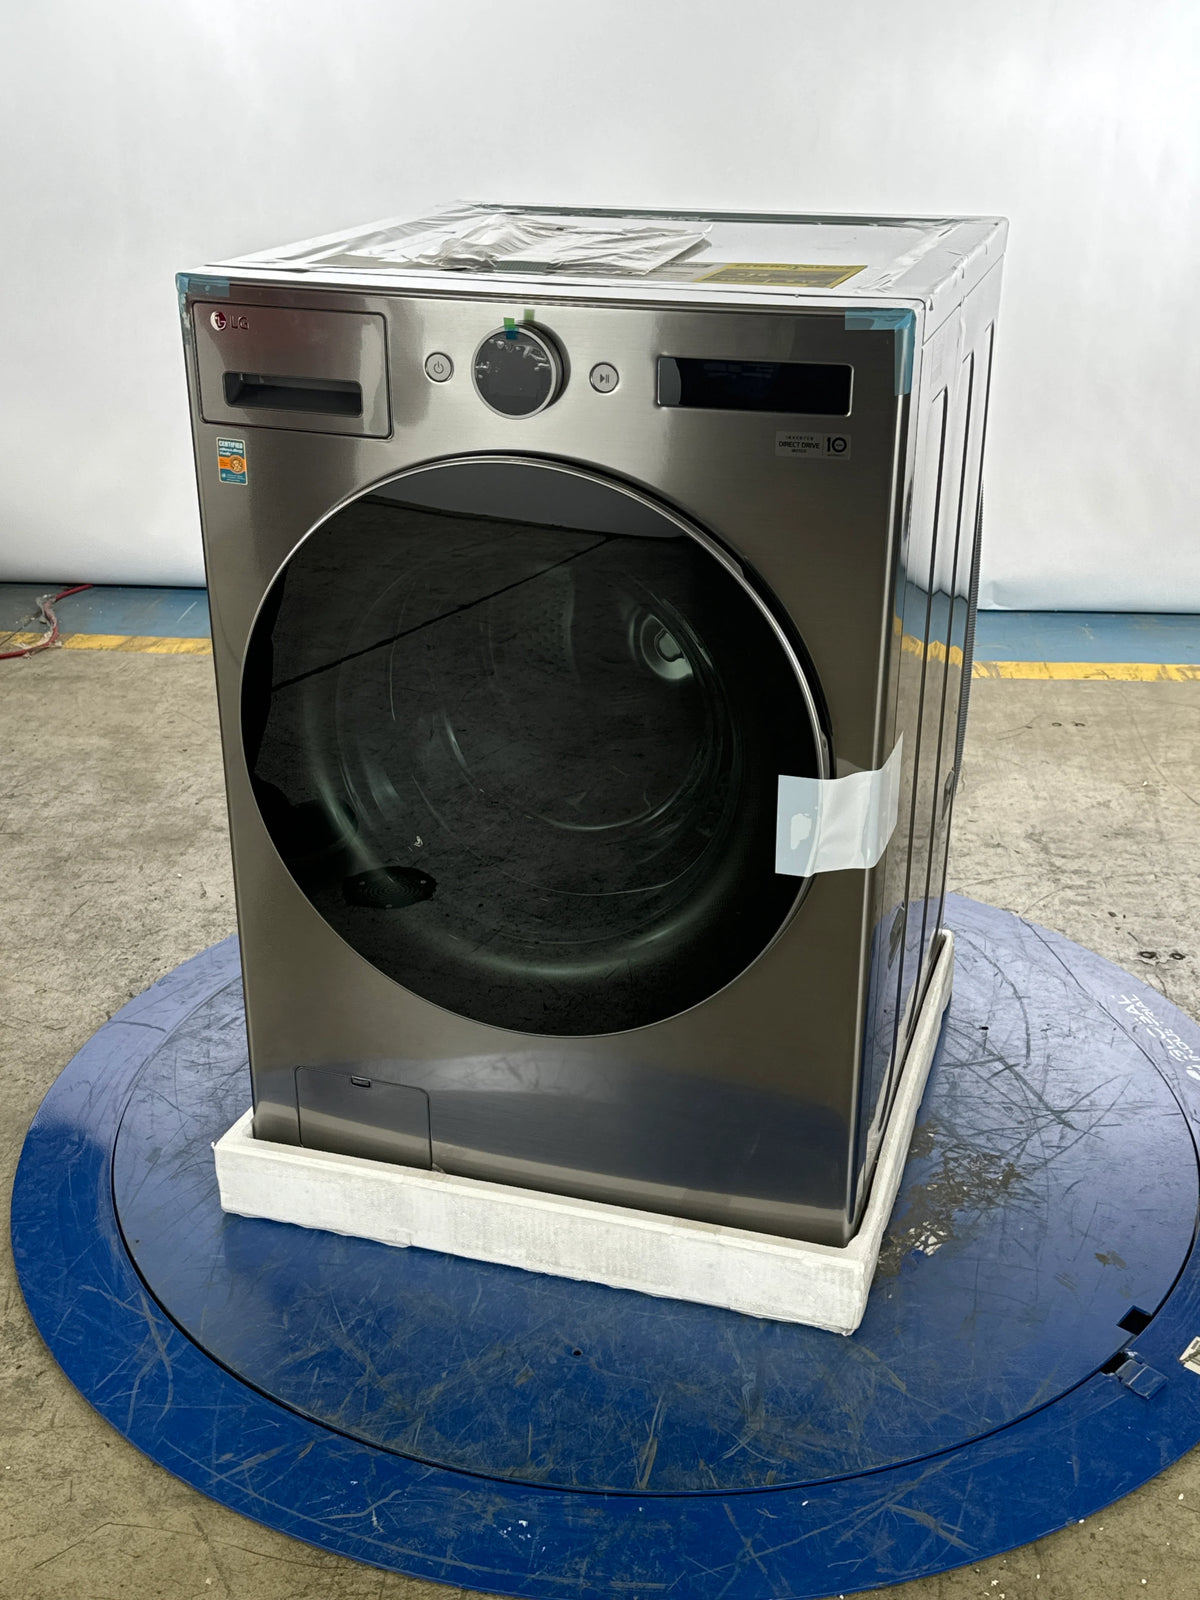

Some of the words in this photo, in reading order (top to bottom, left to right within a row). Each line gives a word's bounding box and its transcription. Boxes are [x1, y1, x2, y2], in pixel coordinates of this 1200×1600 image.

[230, 315, 249, 330] LG
[778, 440, 801, 448] DIRECT
[801, 441, 820, 449] DRIVE
